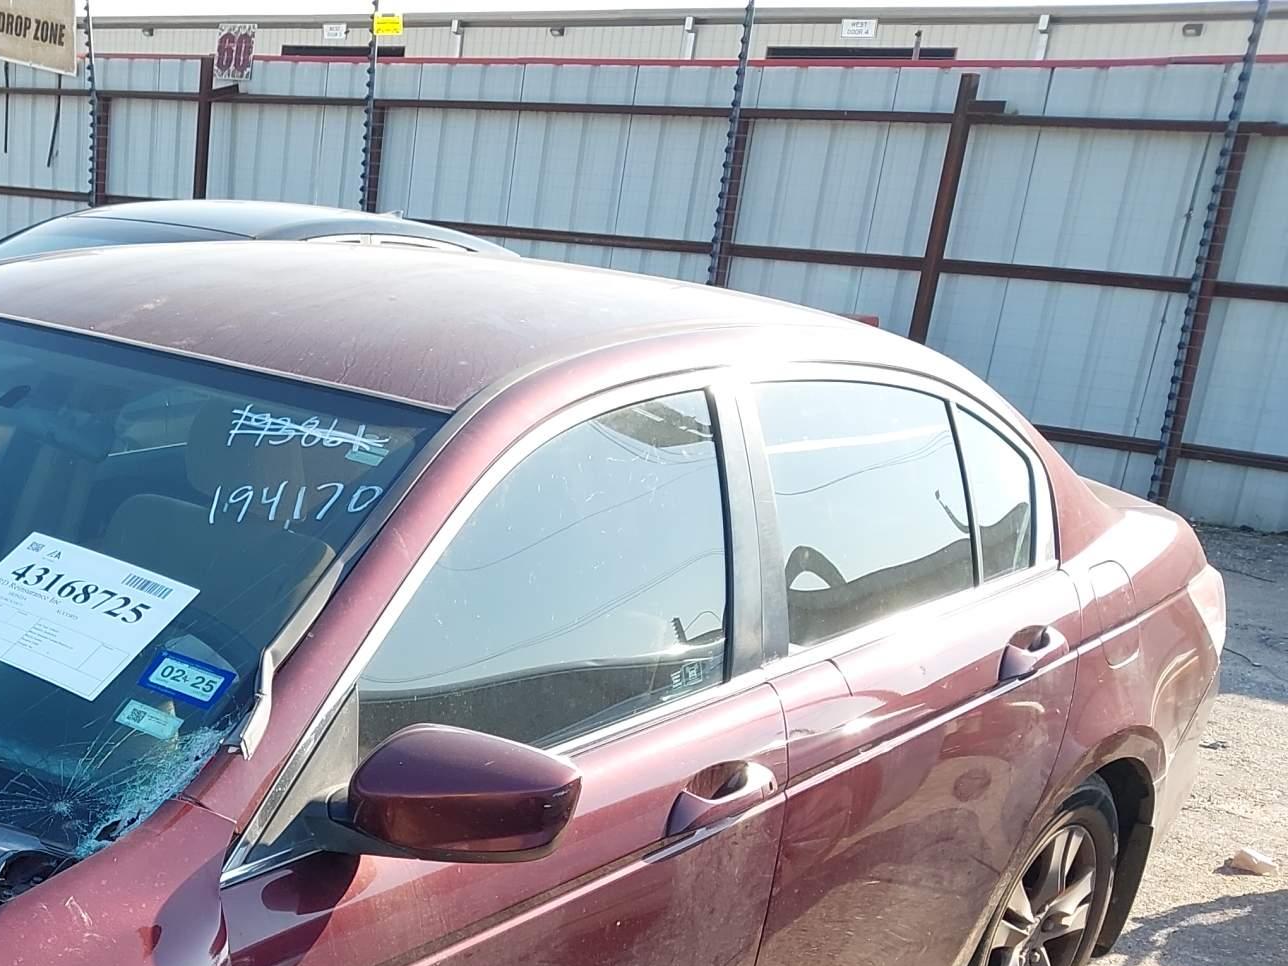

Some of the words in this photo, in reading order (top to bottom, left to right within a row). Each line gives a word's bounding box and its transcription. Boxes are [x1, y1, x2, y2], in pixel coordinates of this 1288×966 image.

[32, 18, 66, 47] ZONE
[216, 32, 252, 72] 60
[10, 563, 152, 624] 43168725
[160, 665, 185, 683] 02
[190, 675, 218, 694] 25
